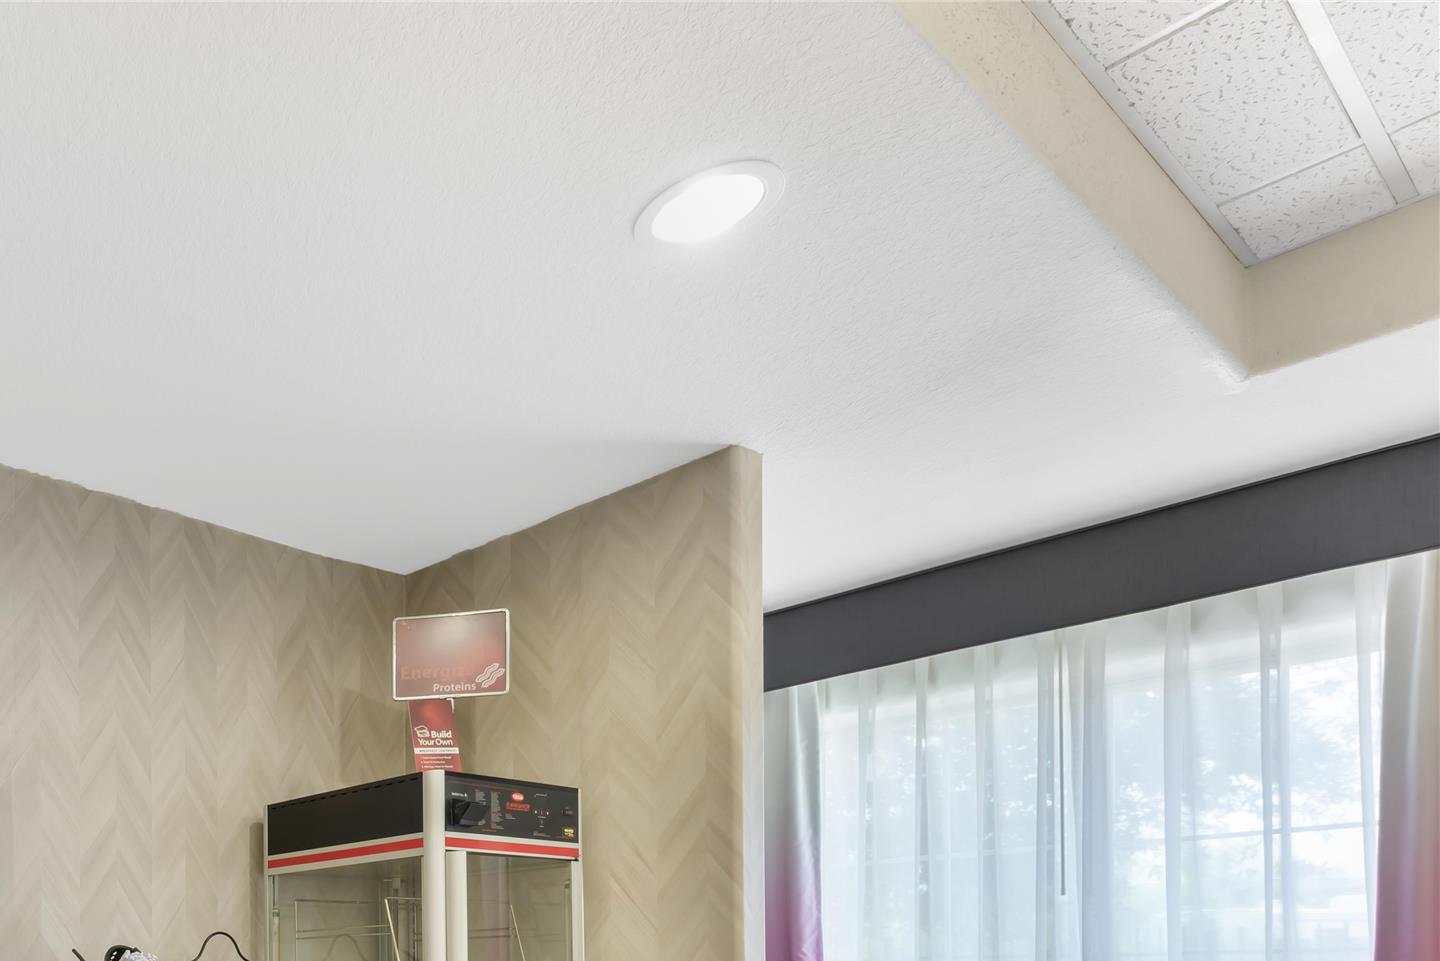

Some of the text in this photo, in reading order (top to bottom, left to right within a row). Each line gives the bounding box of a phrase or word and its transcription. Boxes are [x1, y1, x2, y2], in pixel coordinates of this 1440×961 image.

[433, 681, 477, 693] Proteins
[430, 730, 452, 738] Build
[417, 738, 453, 746] Your Own
